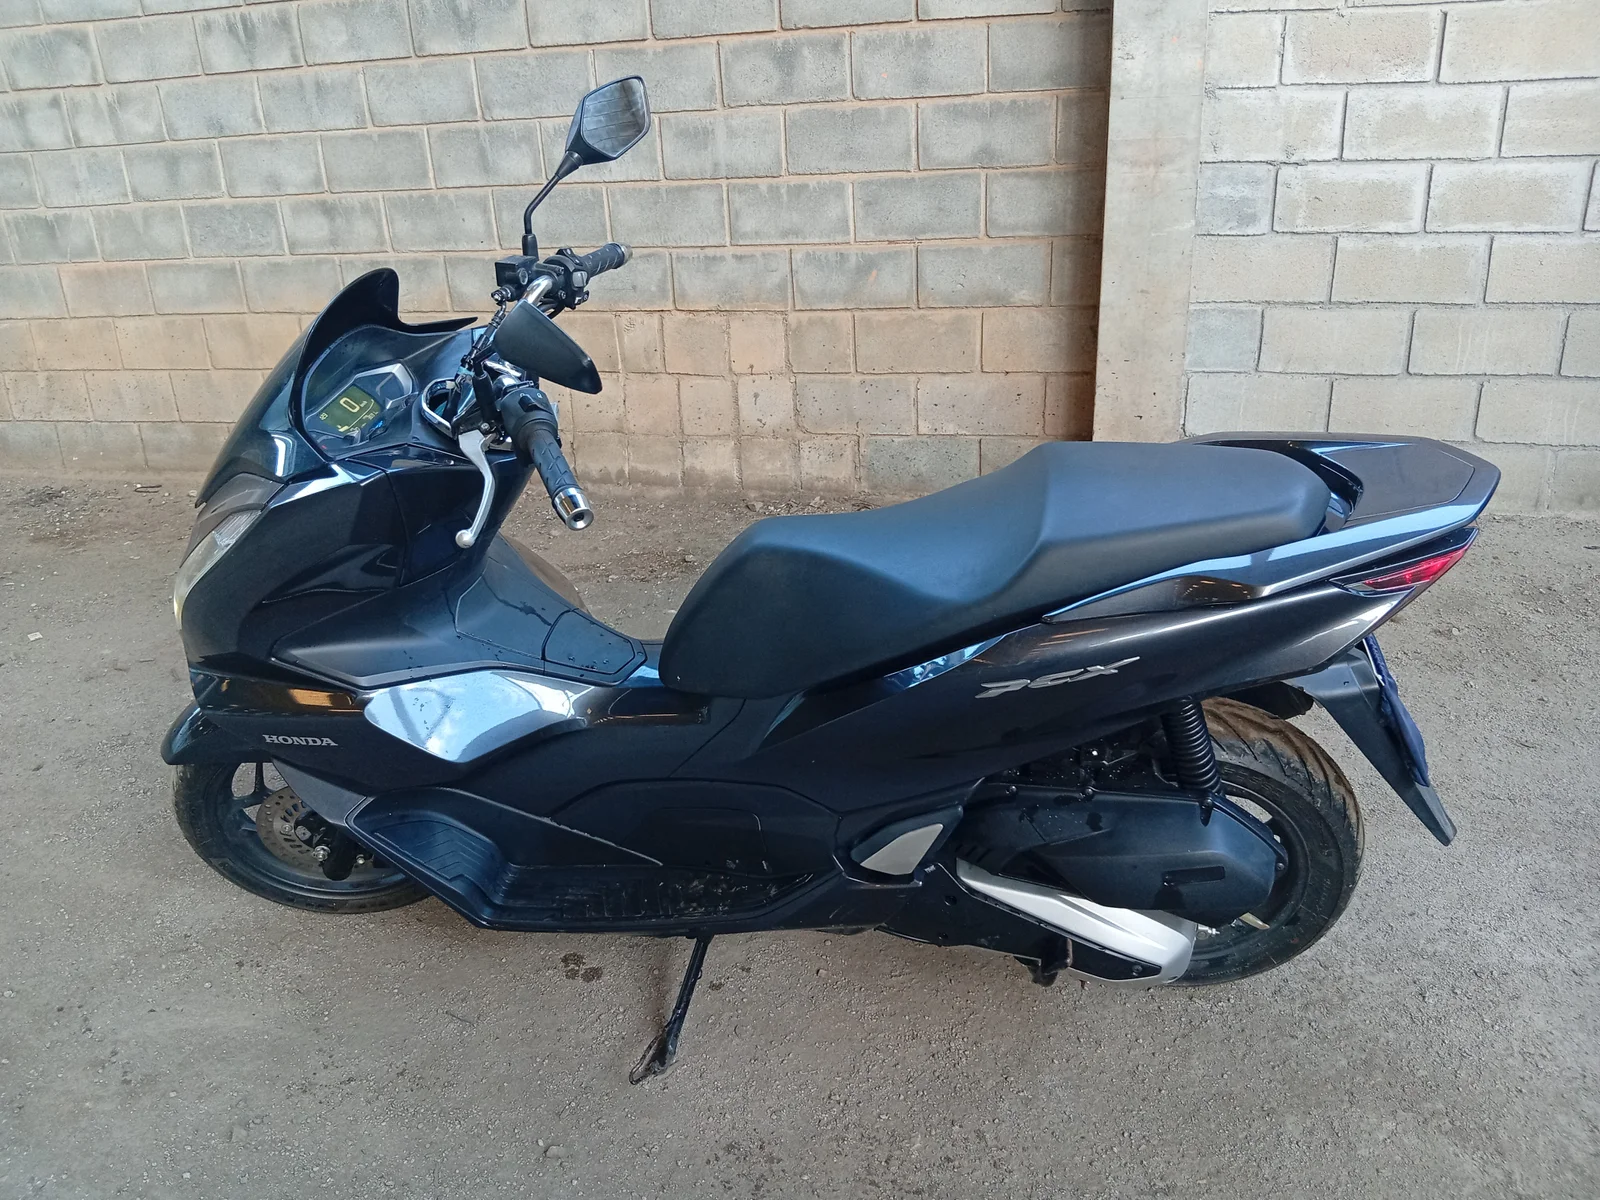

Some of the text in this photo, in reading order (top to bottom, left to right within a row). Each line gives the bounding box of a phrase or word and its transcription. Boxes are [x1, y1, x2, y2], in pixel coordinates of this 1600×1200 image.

[339, 397, 361, 413] 0
[974, 656, 1140, 698] PCX
[262, 734, 339, 747] HONDA
